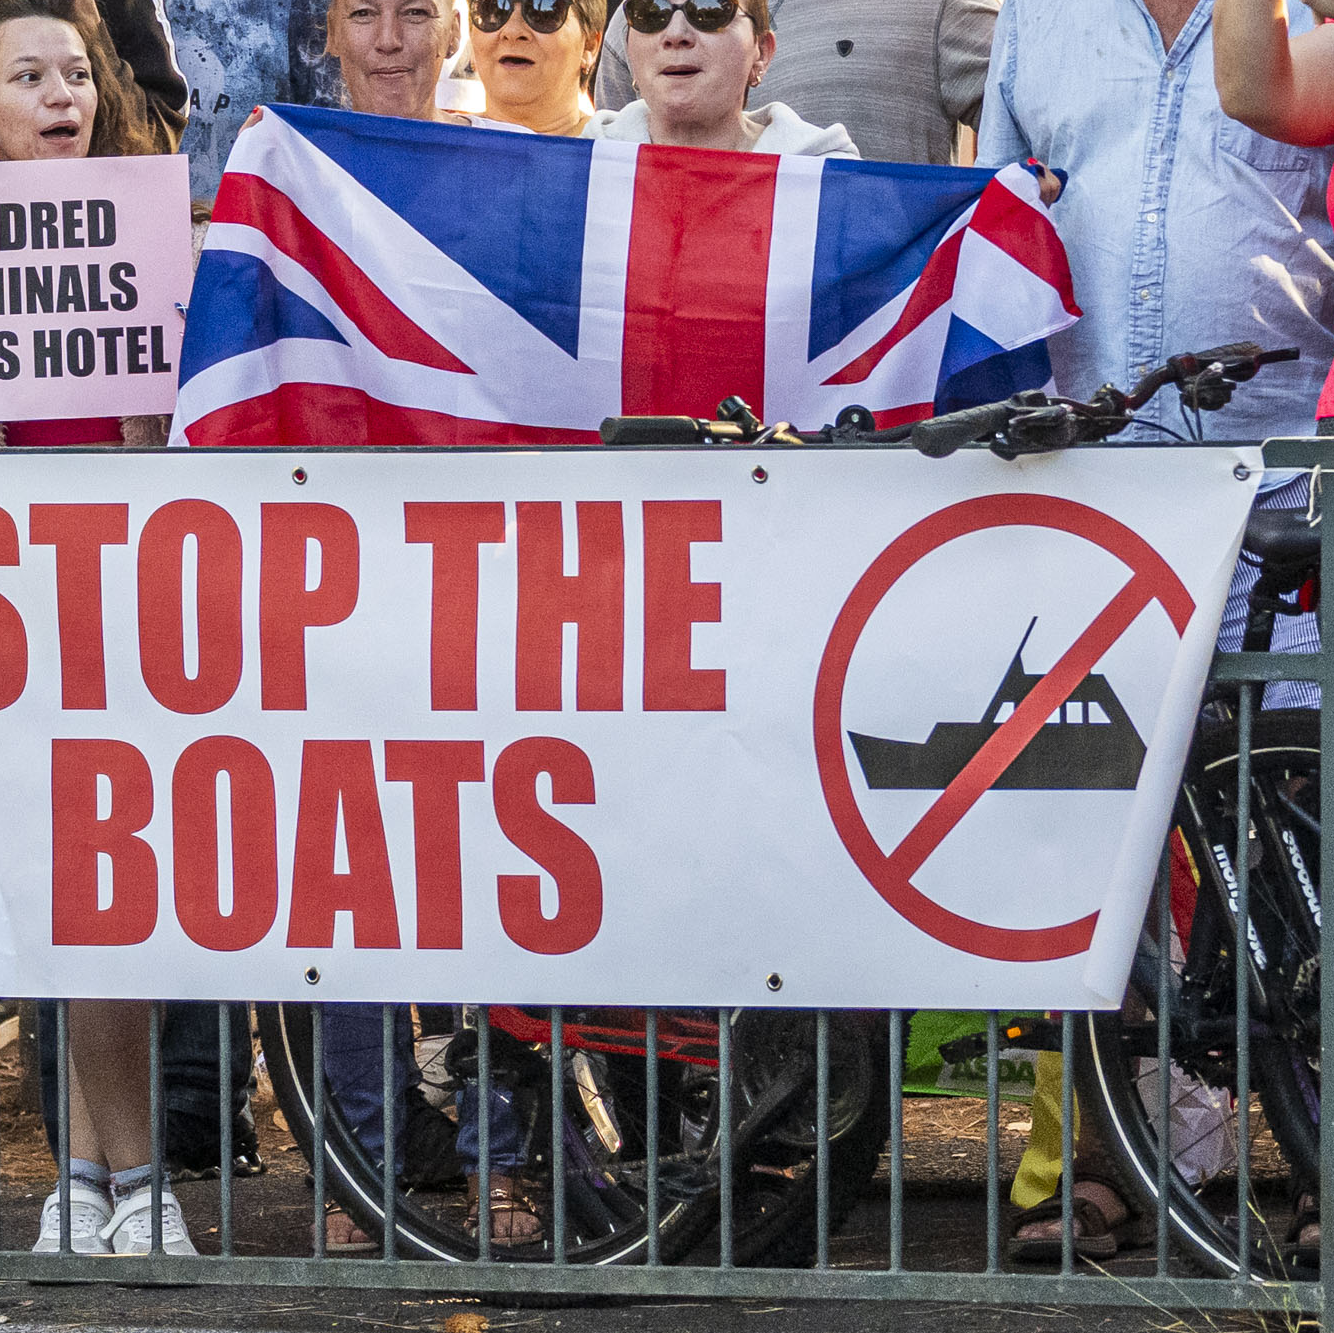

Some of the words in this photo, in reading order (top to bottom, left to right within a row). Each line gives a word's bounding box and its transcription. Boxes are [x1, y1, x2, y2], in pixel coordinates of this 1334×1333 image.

[33, 325, 172, 379] HOTEL
[402, 498, 729, 713] THE
[49, 733, 606, 956] BOATS
